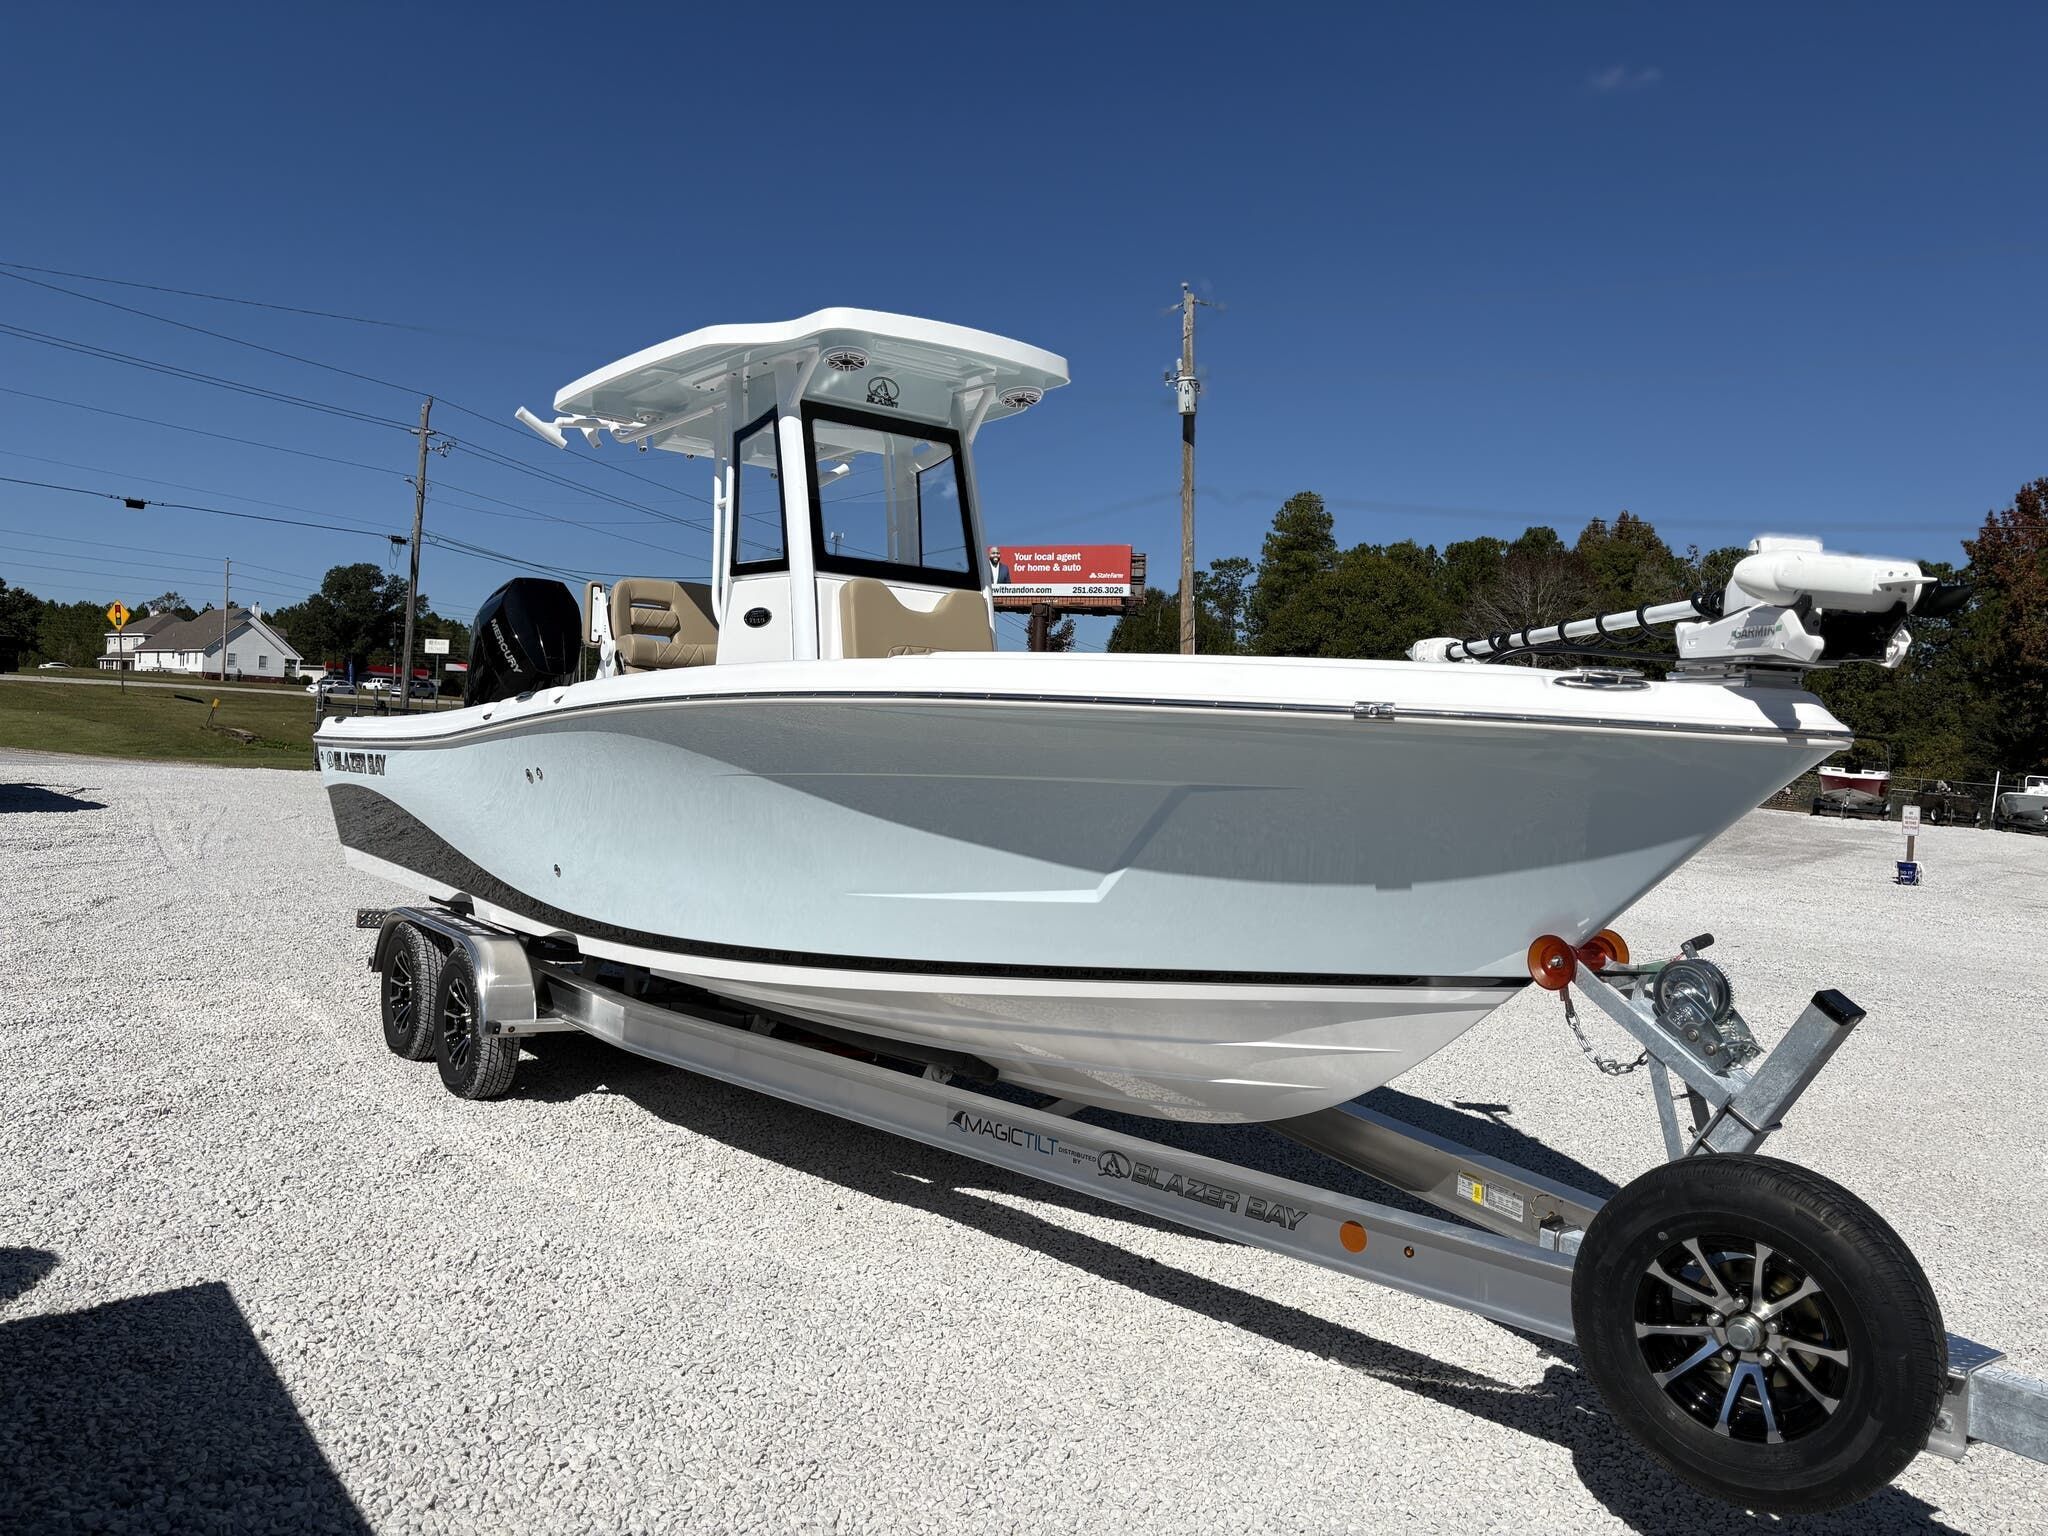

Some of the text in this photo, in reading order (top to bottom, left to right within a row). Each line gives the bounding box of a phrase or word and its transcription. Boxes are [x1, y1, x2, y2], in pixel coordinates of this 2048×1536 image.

[1014, 552, 1081, 562] Your local agent
[1014, 563, 1081, 572] for home & auto
[992, 586, 1124, 594] withrandon.com 251.626.3026
[1734, 625, 1776, 639] GARMIN
[490, 618, 523, 673] MERCURY
[333, 751, 386, 776] BLAZER BAY
[1058, 1147, 1097, 1163] DISTRIBUTED
[1072, 1157, 1081, 1165] BY
[1131, 1162, 1308, 1231] BLAZER BAY
